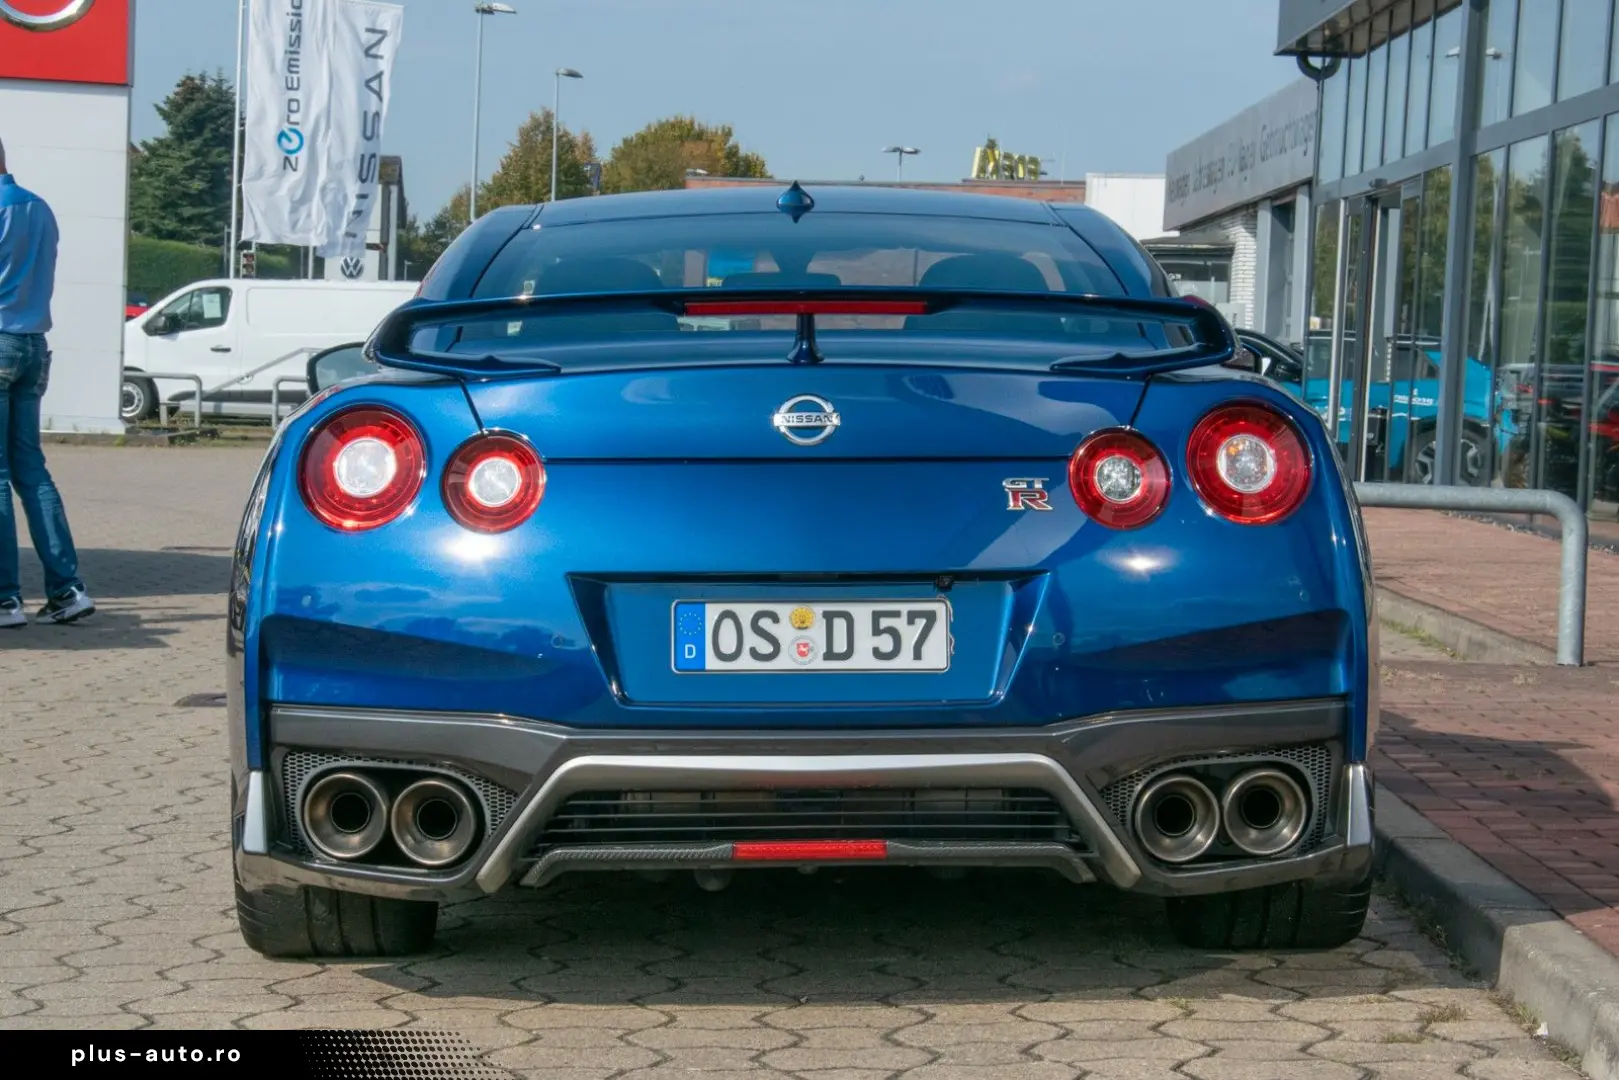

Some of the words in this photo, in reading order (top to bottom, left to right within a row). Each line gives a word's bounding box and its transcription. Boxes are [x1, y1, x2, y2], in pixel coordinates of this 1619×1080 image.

[285, 0, 302, 91] Emissio
[345, 27, 389, 239] NISSAN
[780, 415, 833, 424] NISSAN
[684, 644, 696, 659] D
[711, 609, 781, 662] OS
[822, 610, 855, 661] D
[871, 610, 937, 661] 57
